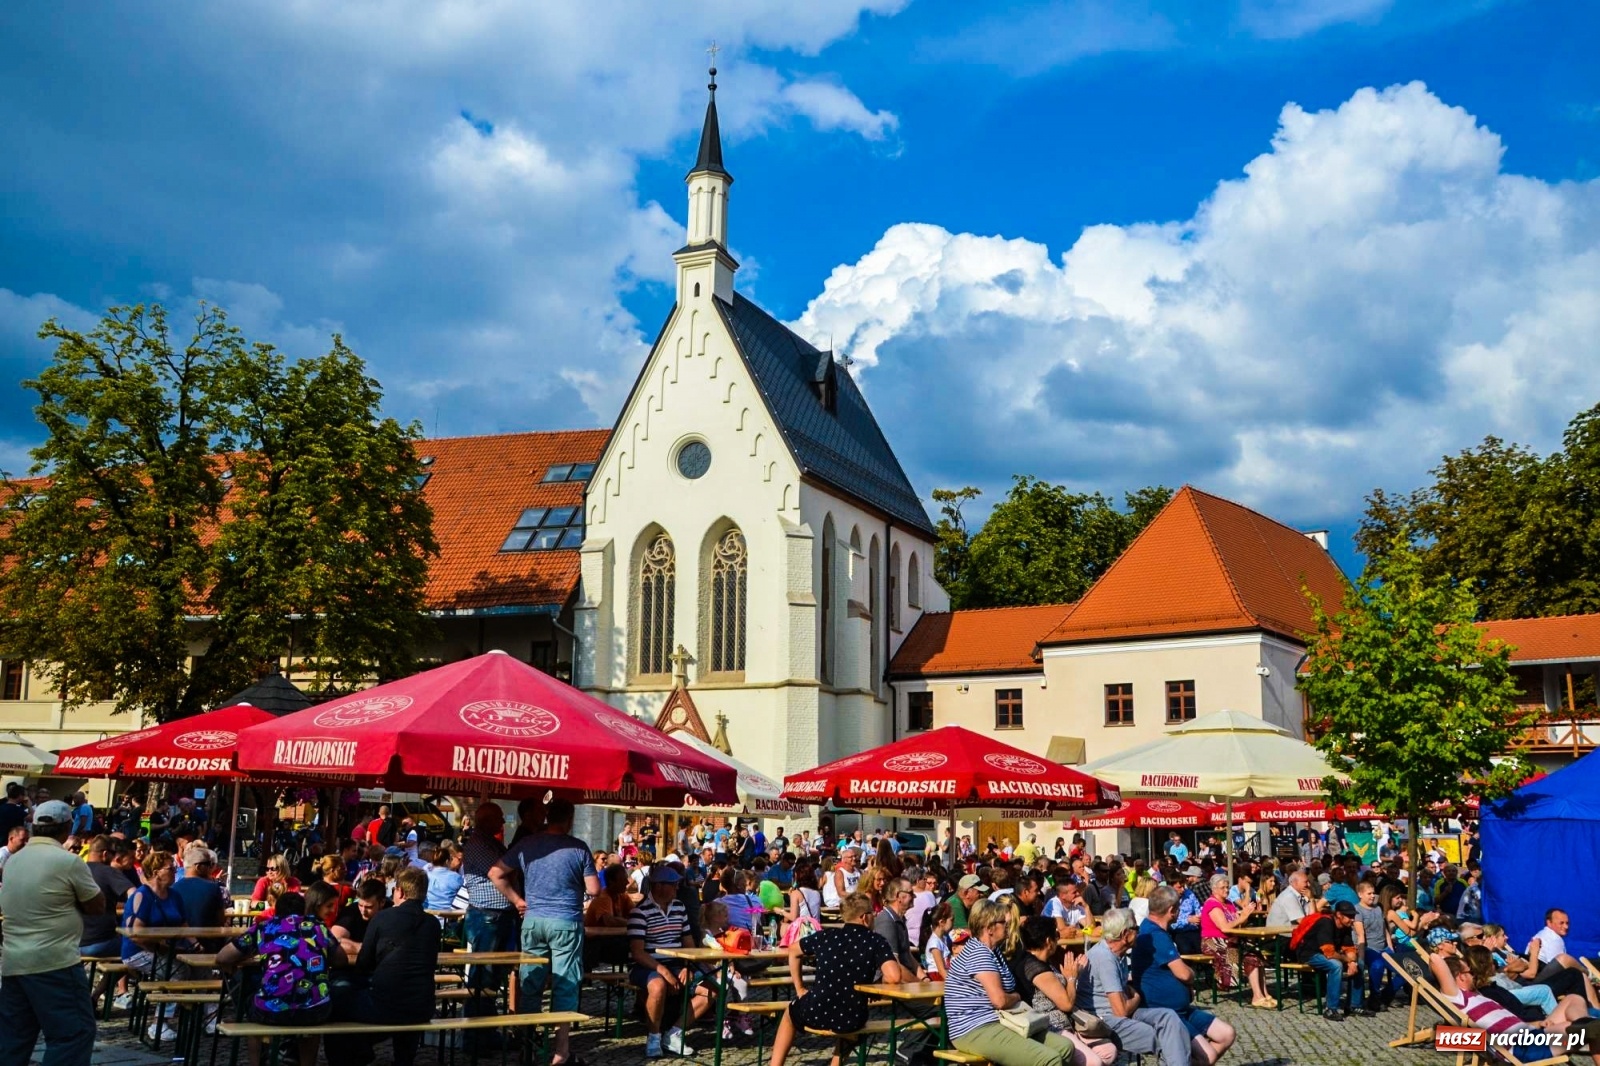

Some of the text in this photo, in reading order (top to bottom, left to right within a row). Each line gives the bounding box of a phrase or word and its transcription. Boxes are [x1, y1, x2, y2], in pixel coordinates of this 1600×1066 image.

[273, 740, 358, 767] RACIBORSKIE
[134, 756, 233, 771] RACIBORSK
[452, 746, 570, 780] RACIBORSKIE
[850, 779, 957, 794] RACIBORSKIE
[988, 780, 1084, 798] RACIBORSKIE
[1141, 774, 1199, 789] RACIBORSKIE
[755, 798, 805, 813] RACIBORSKIE
[1140, 816, 1198, 826] RACIBORSKIE
[1260, 809, 1326, 819] RACIBORSKIE
[1079, 817, 1126, 828] RACIBORSKIE
